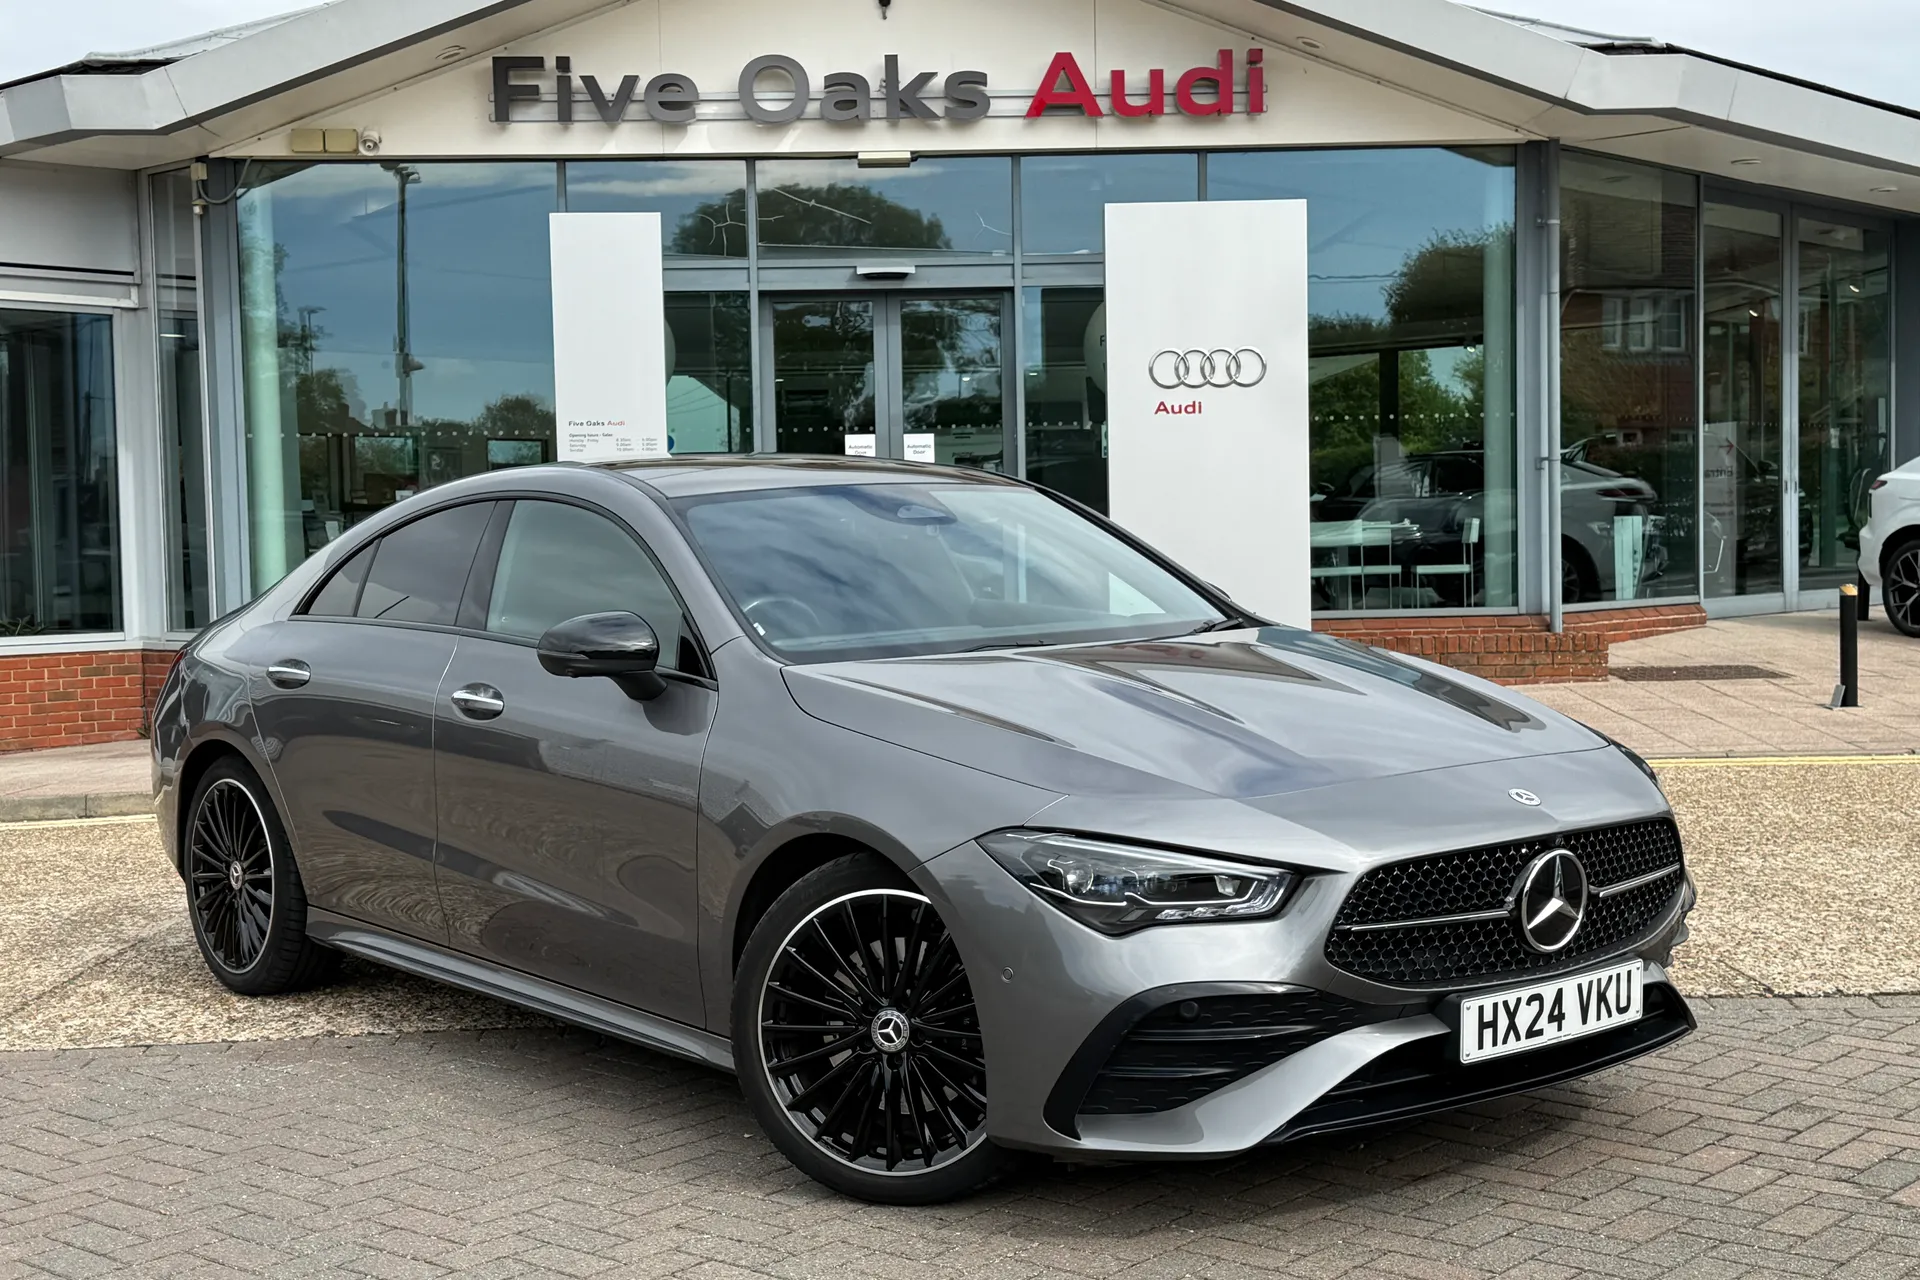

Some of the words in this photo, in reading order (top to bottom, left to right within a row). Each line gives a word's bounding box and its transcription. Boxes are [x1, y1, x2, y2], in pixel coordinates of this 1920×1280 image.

[491, 56, 700, 124] Five
[738, 54, 991, 124] Oaks
[1024, 48, 1263, 119] Audi
[1154, 400, 1202, 414] Audi
[1477, 988, 1566, 1051] HX24
[1577, 969, 1632, 1026] VKU
